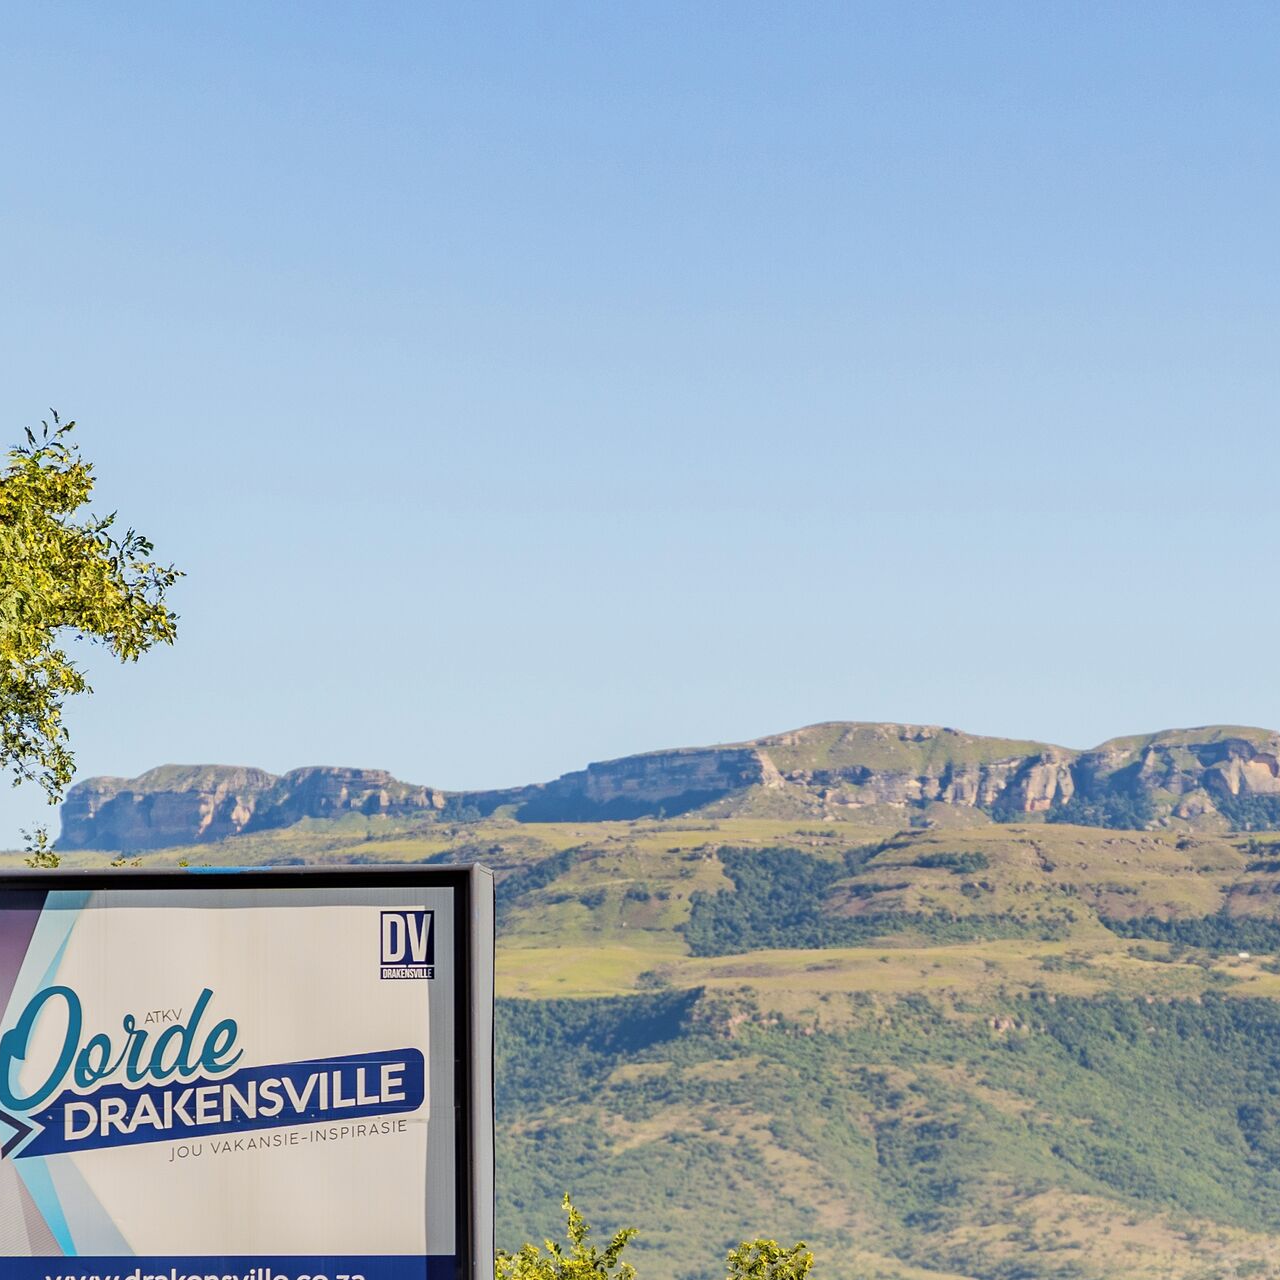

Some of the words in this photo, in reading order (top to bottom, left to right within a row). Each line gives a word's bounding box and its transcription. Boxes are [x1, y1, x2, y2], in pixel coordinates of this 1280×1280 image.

[383, 914, 431, 962] DV
[382, 968, 432, 979] DRAKENSVILLE
[144, 1008, 183, 1025] ATKV
[64, 1062, 406, 1142] DRAKENSVILLE
[169, 1143, 203, 1162] JOU
[210, 1119, 408, 1154] VAKANSIE-INSPIRASIE
